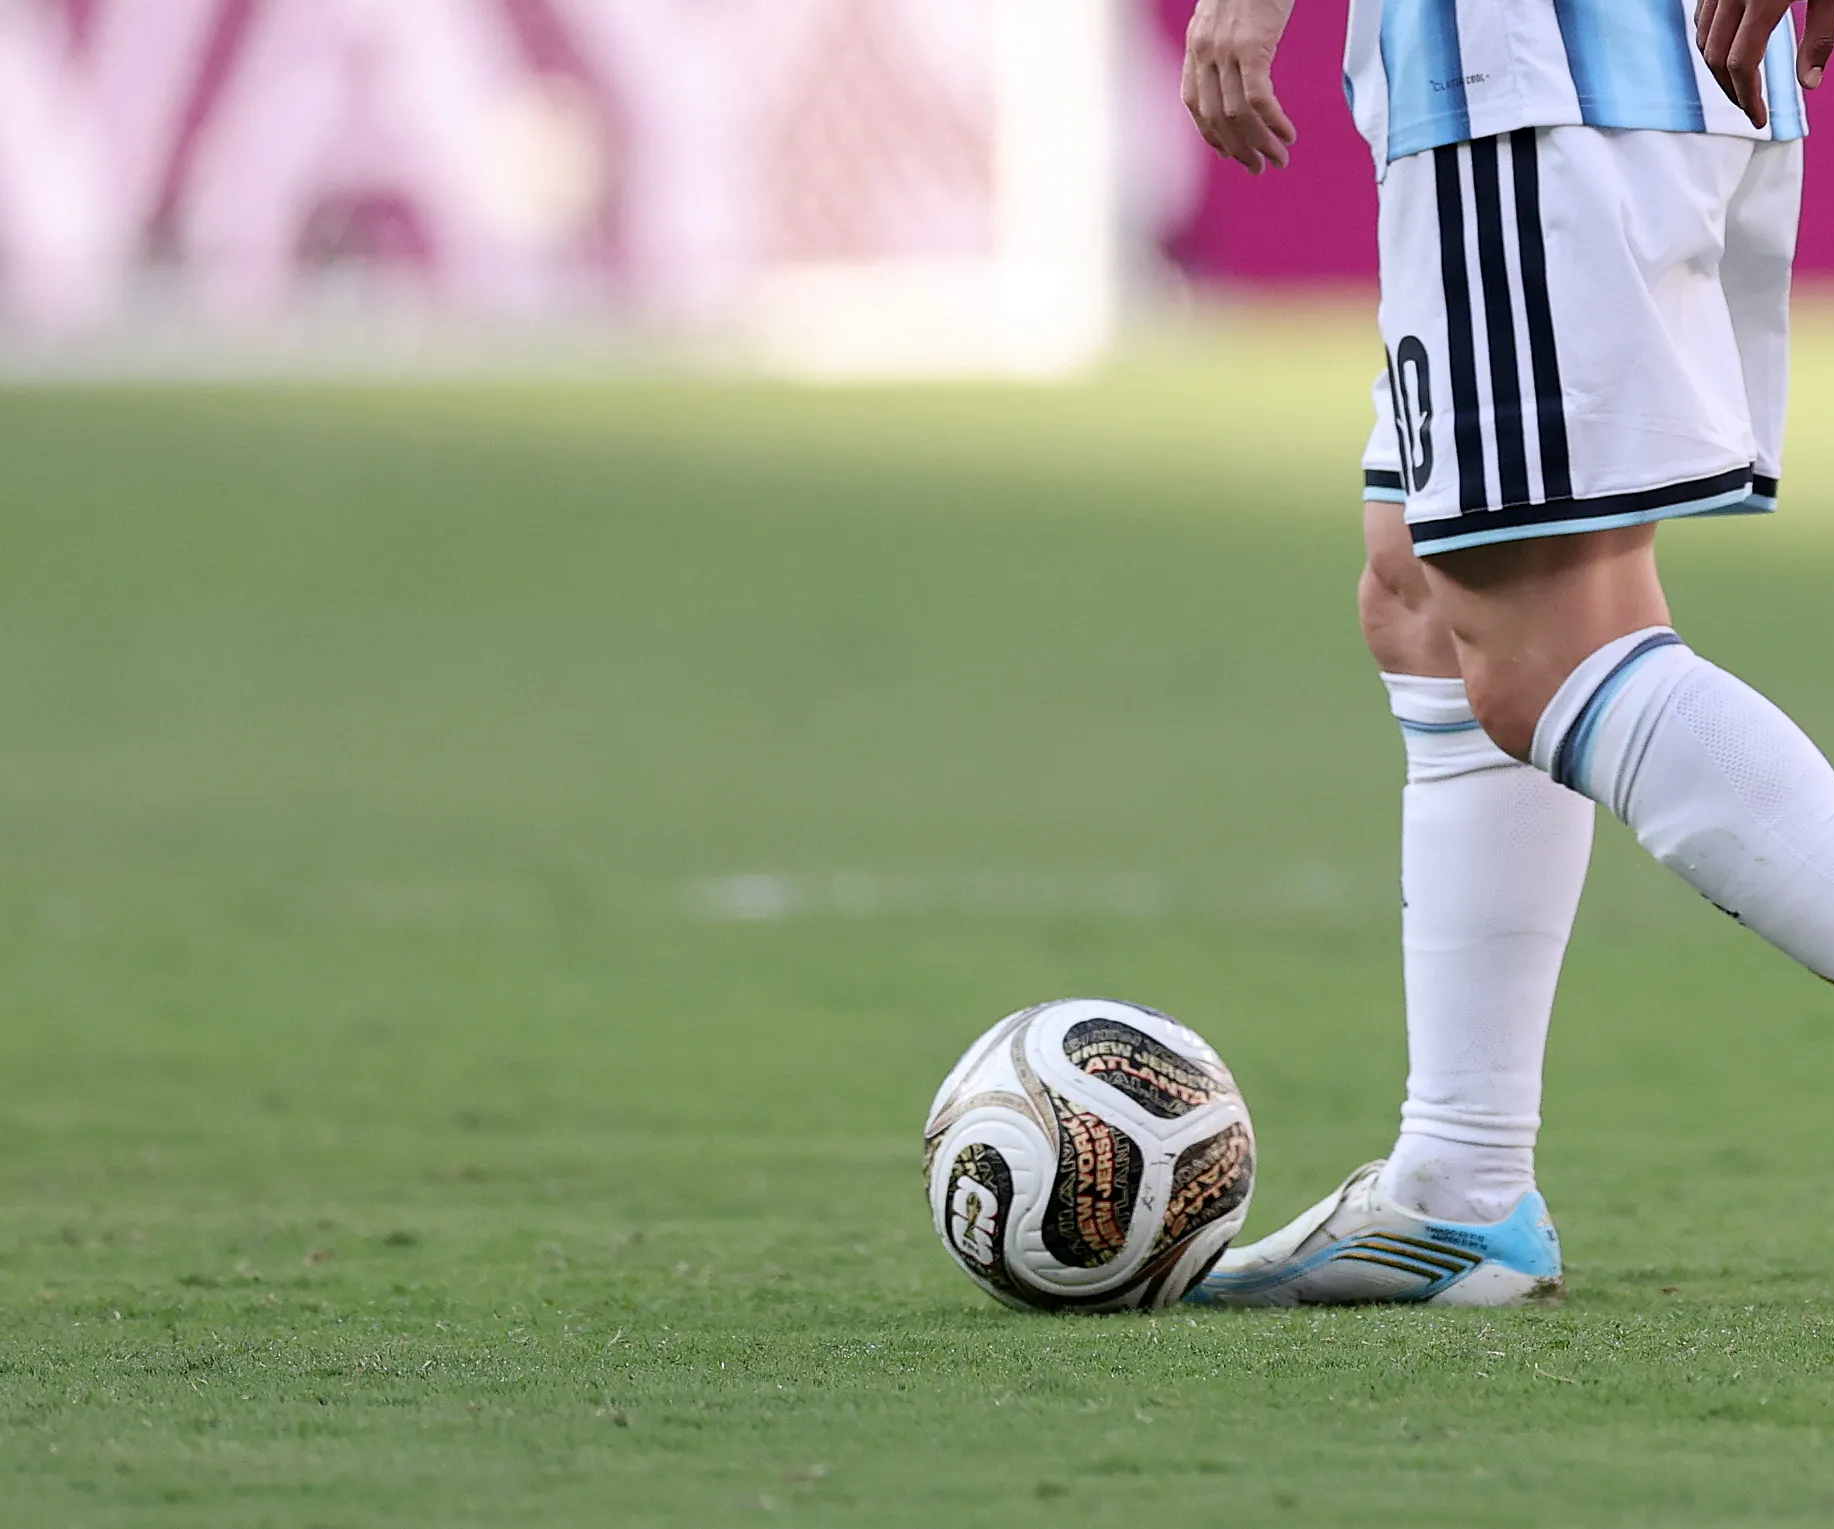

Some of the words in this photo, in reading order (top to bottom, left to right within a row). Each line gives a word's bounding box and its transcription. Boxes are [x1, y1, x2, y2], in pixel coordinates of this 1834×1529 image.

[1085, 1055, 1209, 1105] ATLANTA
[1061, 1116, 1095, 1192] YORK
[1078, 1112, 1114, 1199] JERSEY
[1076, 1195, 1109, 1250] NEW
